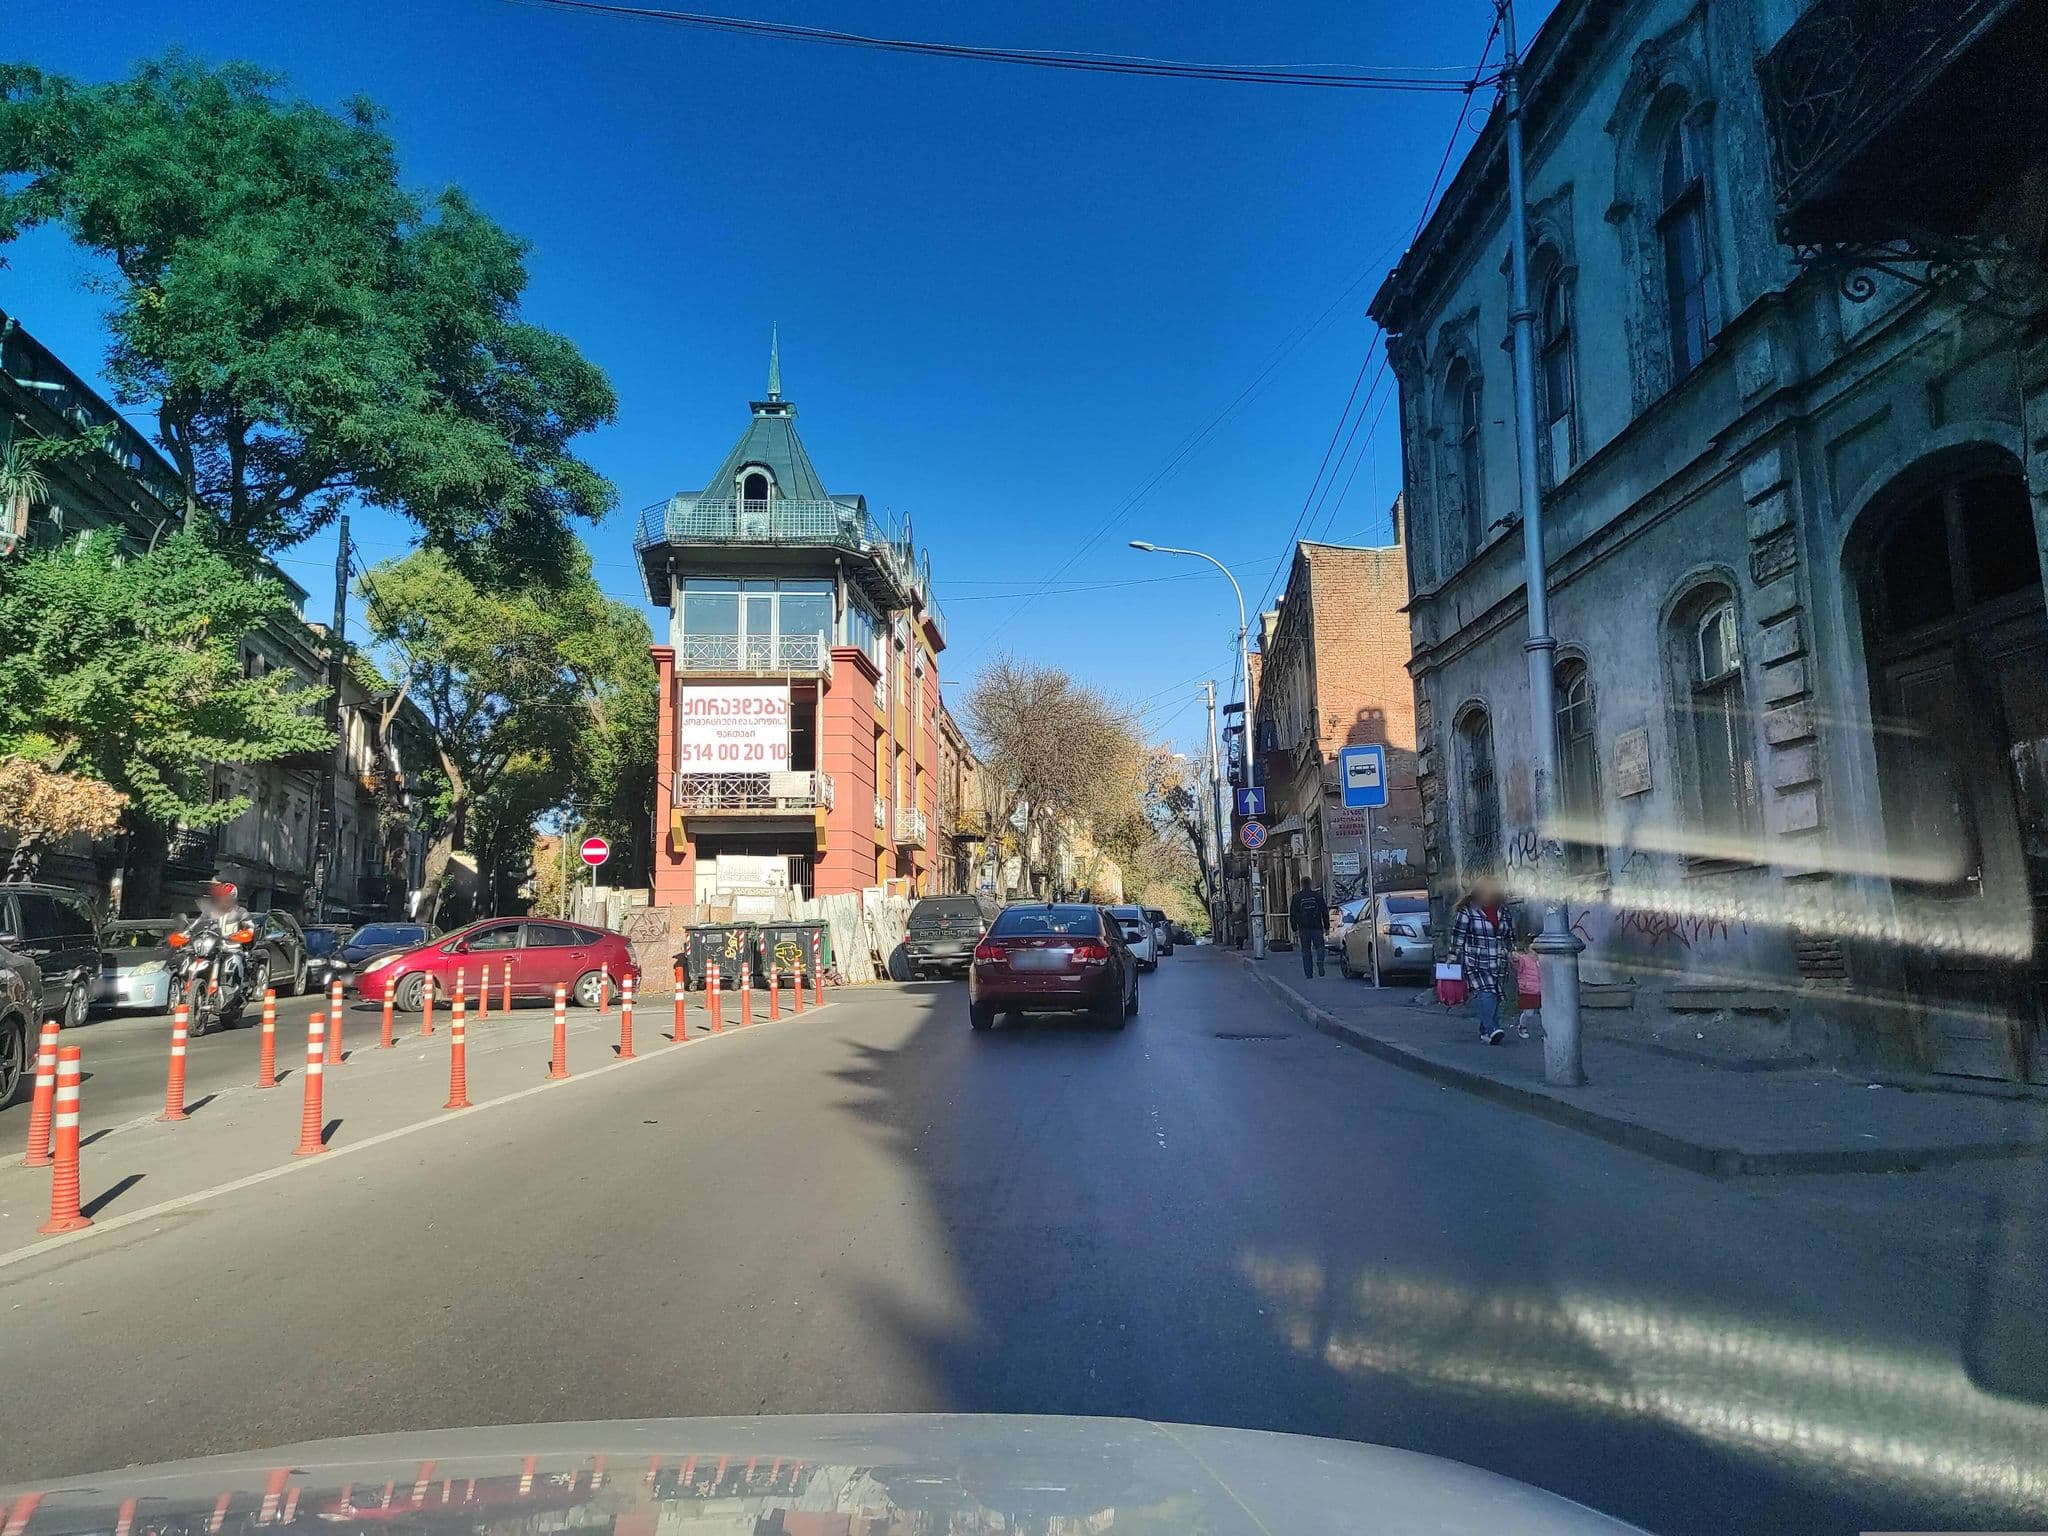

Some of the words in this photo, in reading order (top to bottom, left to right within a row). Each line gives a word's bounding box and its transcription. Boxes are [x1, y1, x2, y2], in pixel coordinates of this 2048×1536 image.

[684, 698, 787, 715] ქირავდება
[716, 730, 756, 738] ფართები
[682, 743, 713, 761] 514
[718, 743, 739, 761] 00
[743, 743, 764, 761] 20
[769, 743, 787, 761] 10
